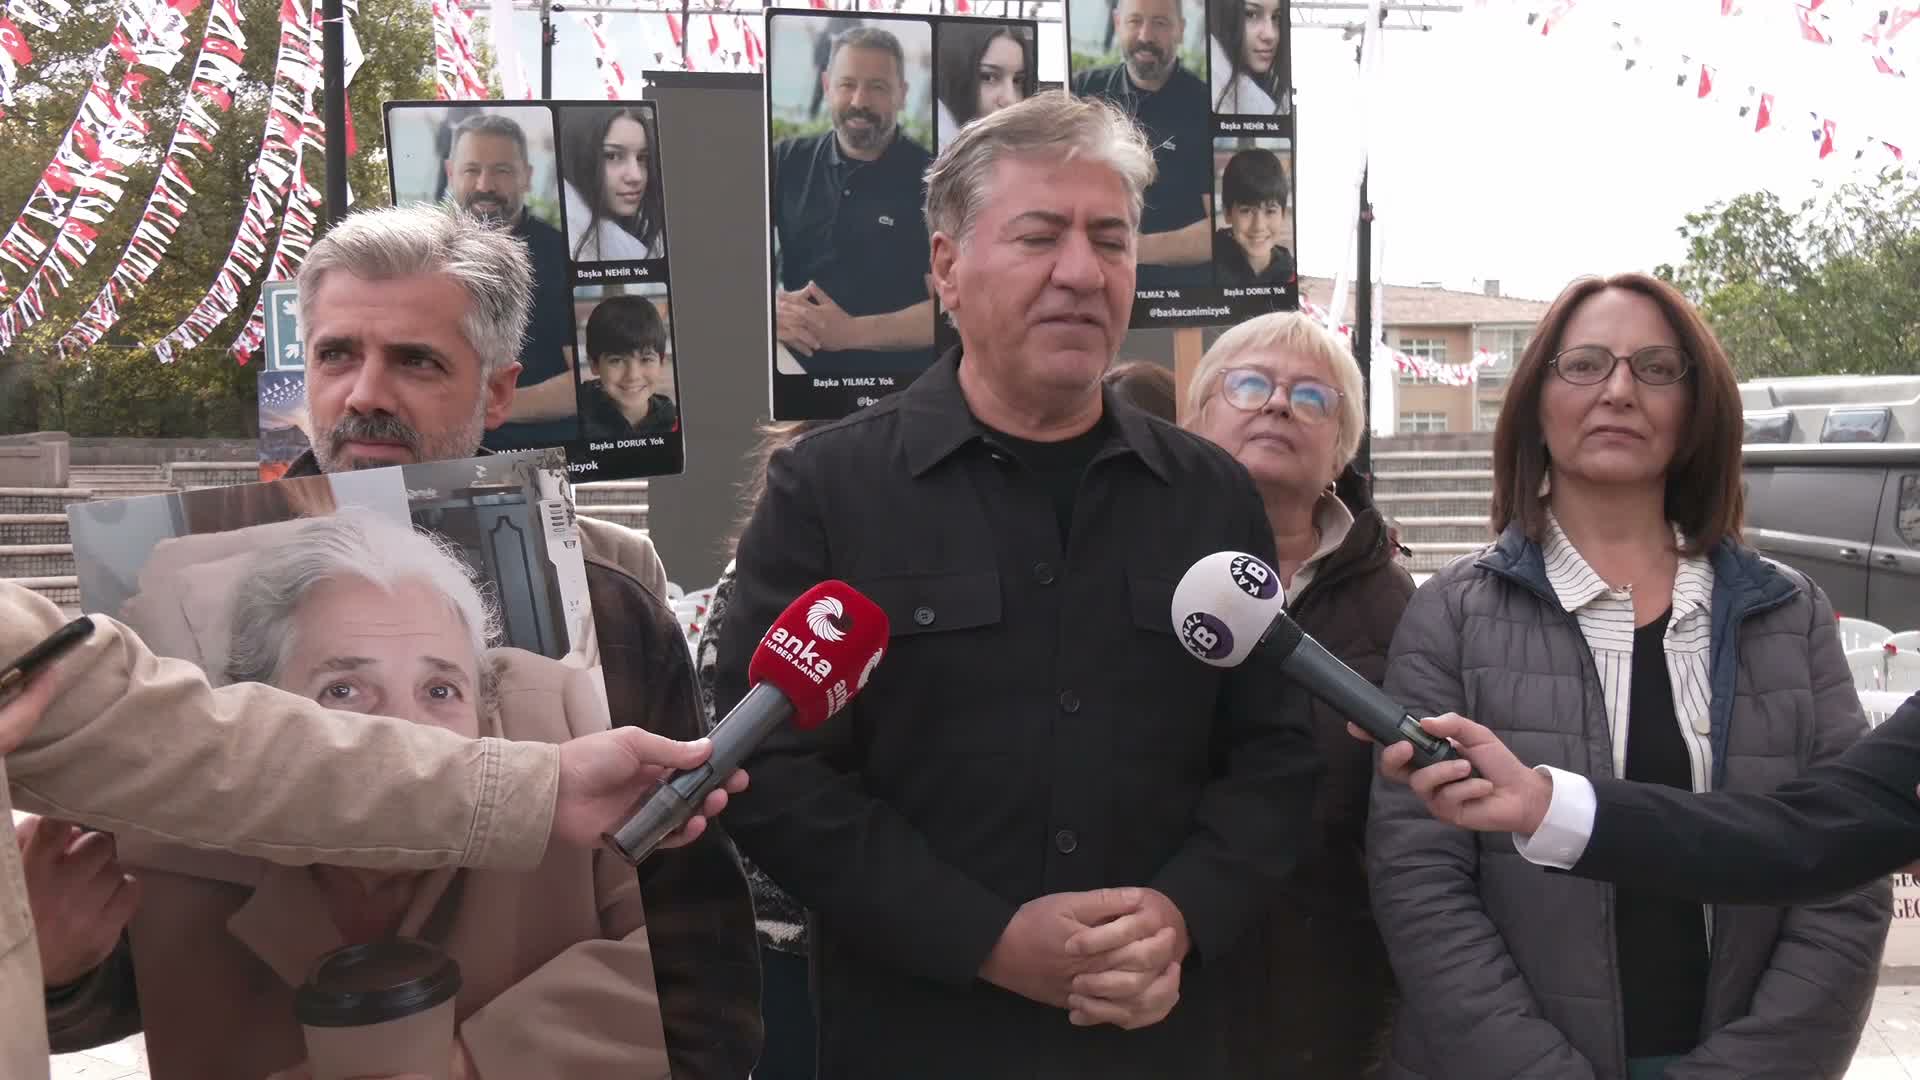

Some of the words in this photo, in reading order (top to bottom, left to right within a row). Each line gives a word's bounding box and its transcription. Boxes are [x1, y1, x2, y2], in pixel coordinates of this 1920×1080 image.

[1220, 122, 1241, 131] Başka
[1266, 122, 1280, 130] Yok
[577, 269, 602, 279] Başka
[605, 267, 631, 277] NEHİR
[633, 267, 649, 276] Yok
[1136, 290, 1165, 299] YILMAZ
[1167, 290, 1180, 298] Yok
[1223, 288, 1244, 298] Başka
[1245, 287, 1271, 296] DORUK
[1273, 287, 1286, 295] Yok
[1149, 306, 1231, 318] @baskacanimizyok
[813, 378, 839, 388] Başka
[842, 377, 876, 386] YILMAZ
[878, 377, 894, 386] Yok
[590, 441, 615, 451] Başka
[617, 439, 647, 449] DORUK
[649, 437, 665, 446] Yok
[1231, 555, 1260, 596] KANAL
[1245, 562, 1269, 584] B
[1183, 614, 1207, 657] KANAL
[1192, 626, 1219, 650] B
[771, 627, 833, 678] anka
[765, 639, 794, 663] HABER
[791, 658, 823, 685] AJANSI
